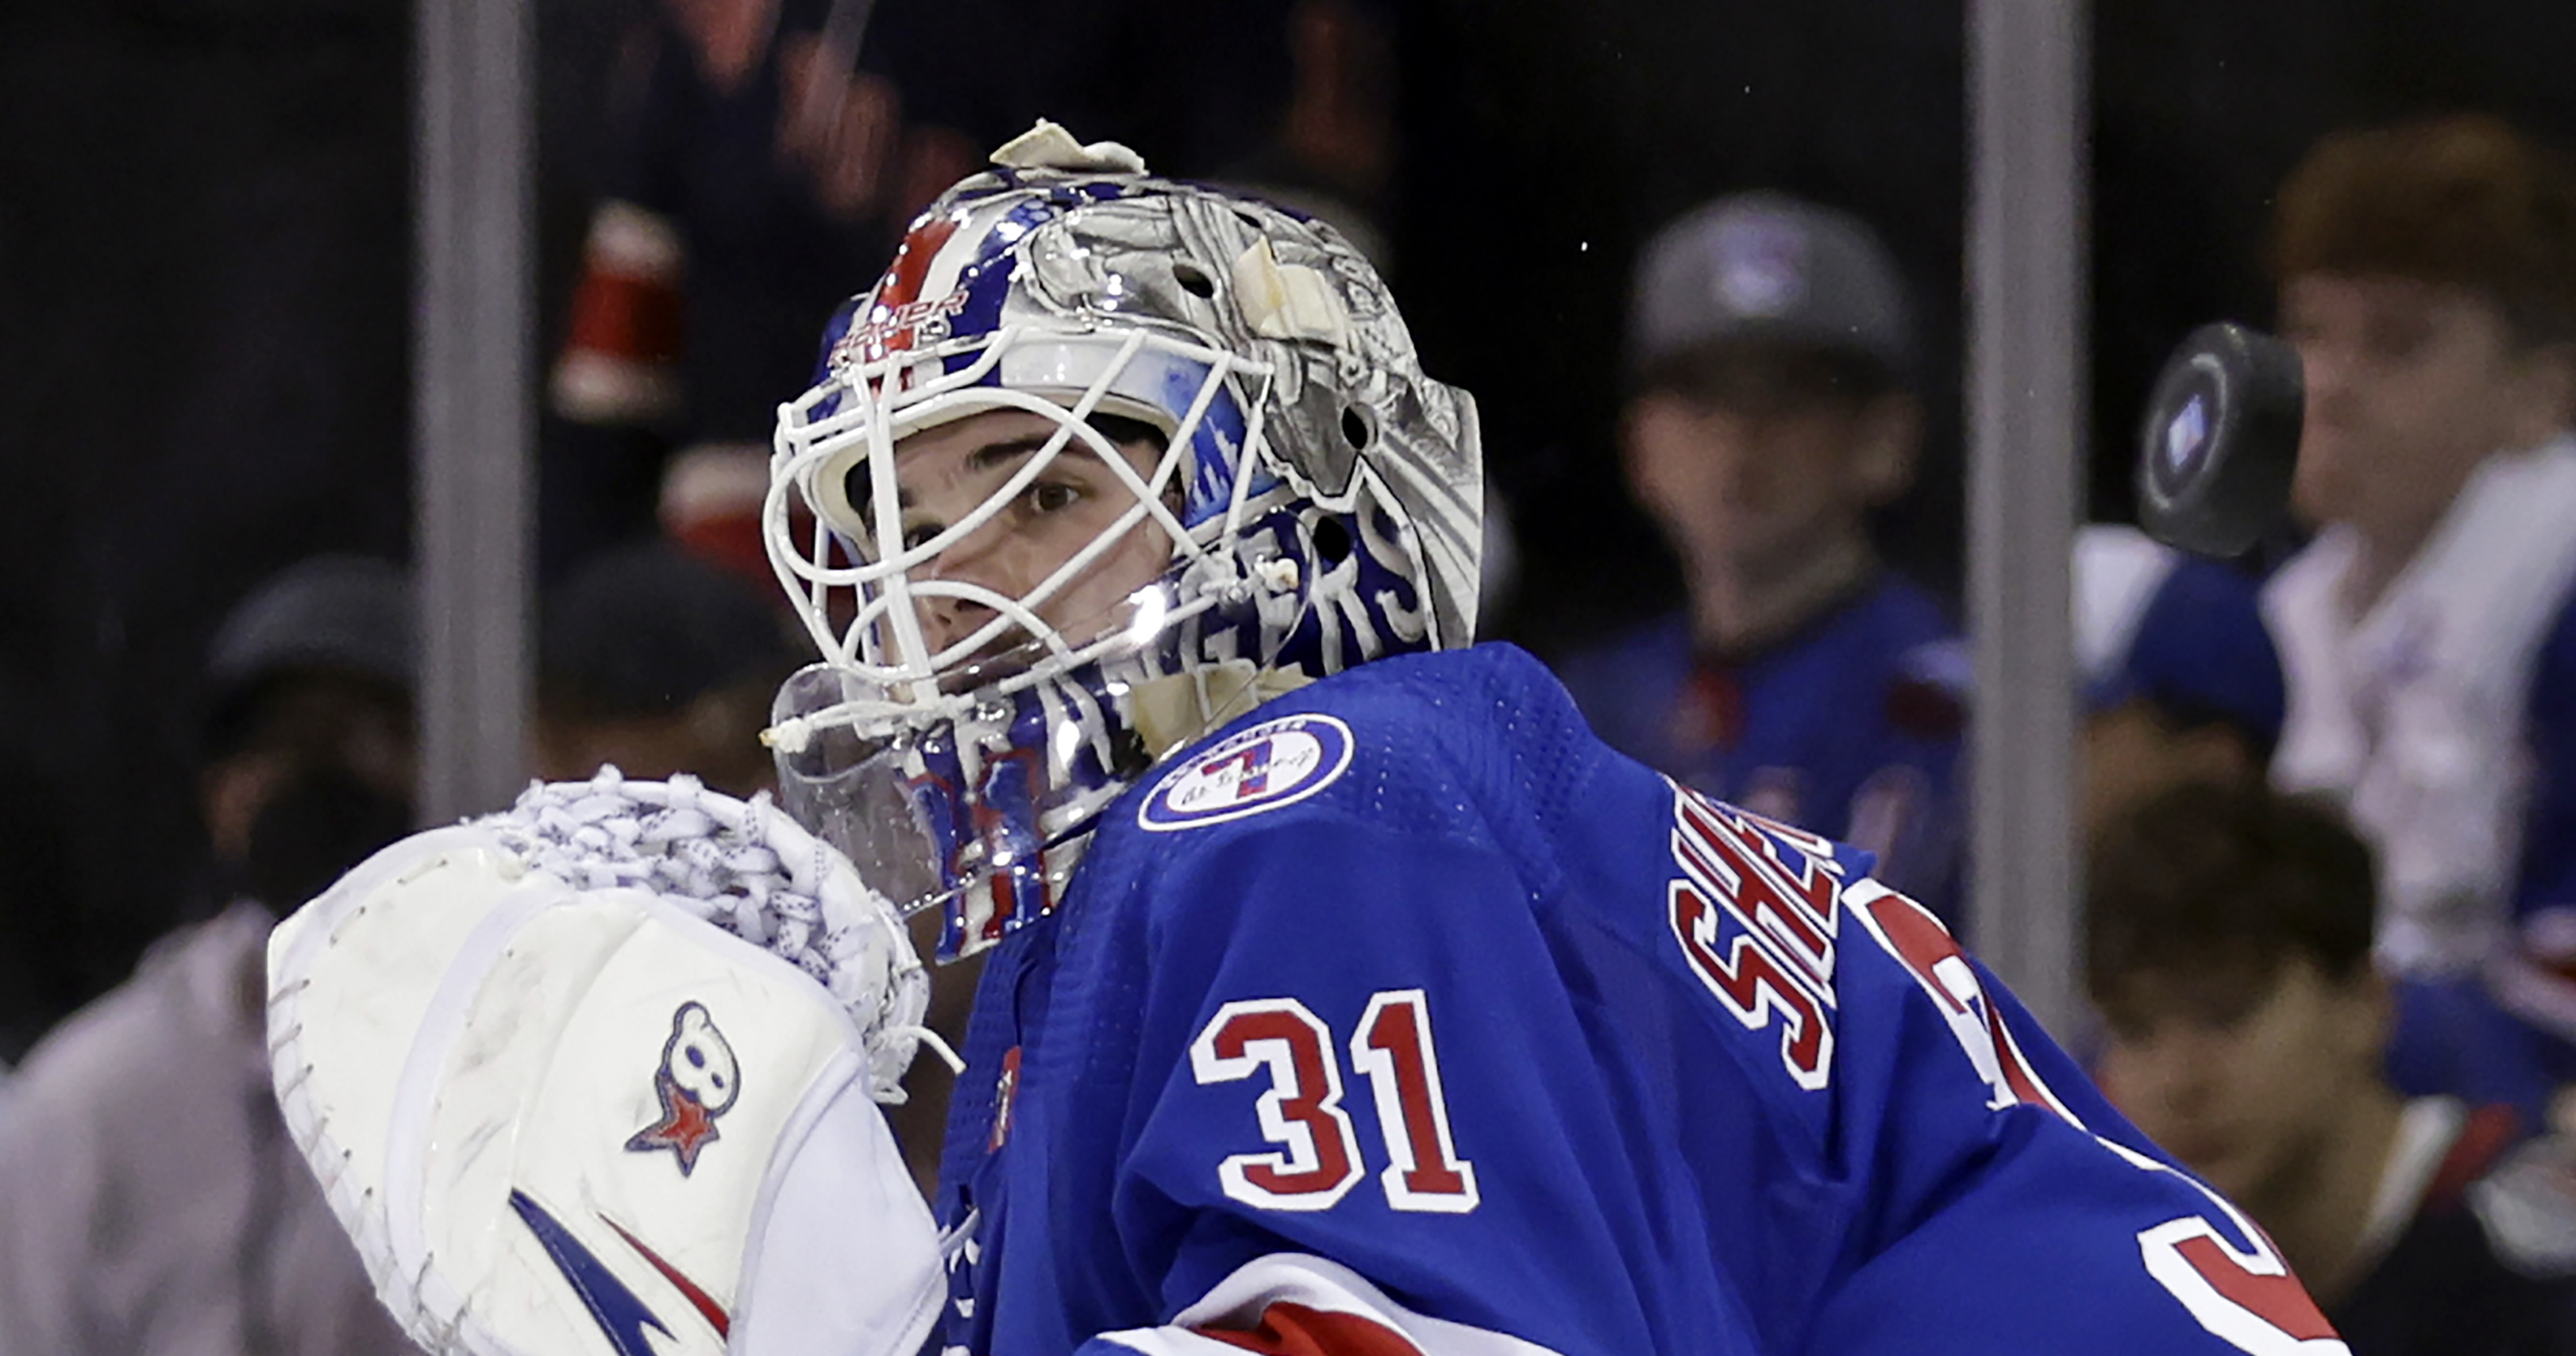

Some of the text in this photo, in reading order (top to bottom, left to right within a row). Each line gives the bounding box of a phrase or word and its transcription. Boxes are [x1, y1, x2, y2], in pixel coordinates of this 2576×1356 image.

[1201, 738, 1274, 800] 7
[1668, 773, 1845, 1091] SHE
[1189, 988, 1481, 1214] 31
